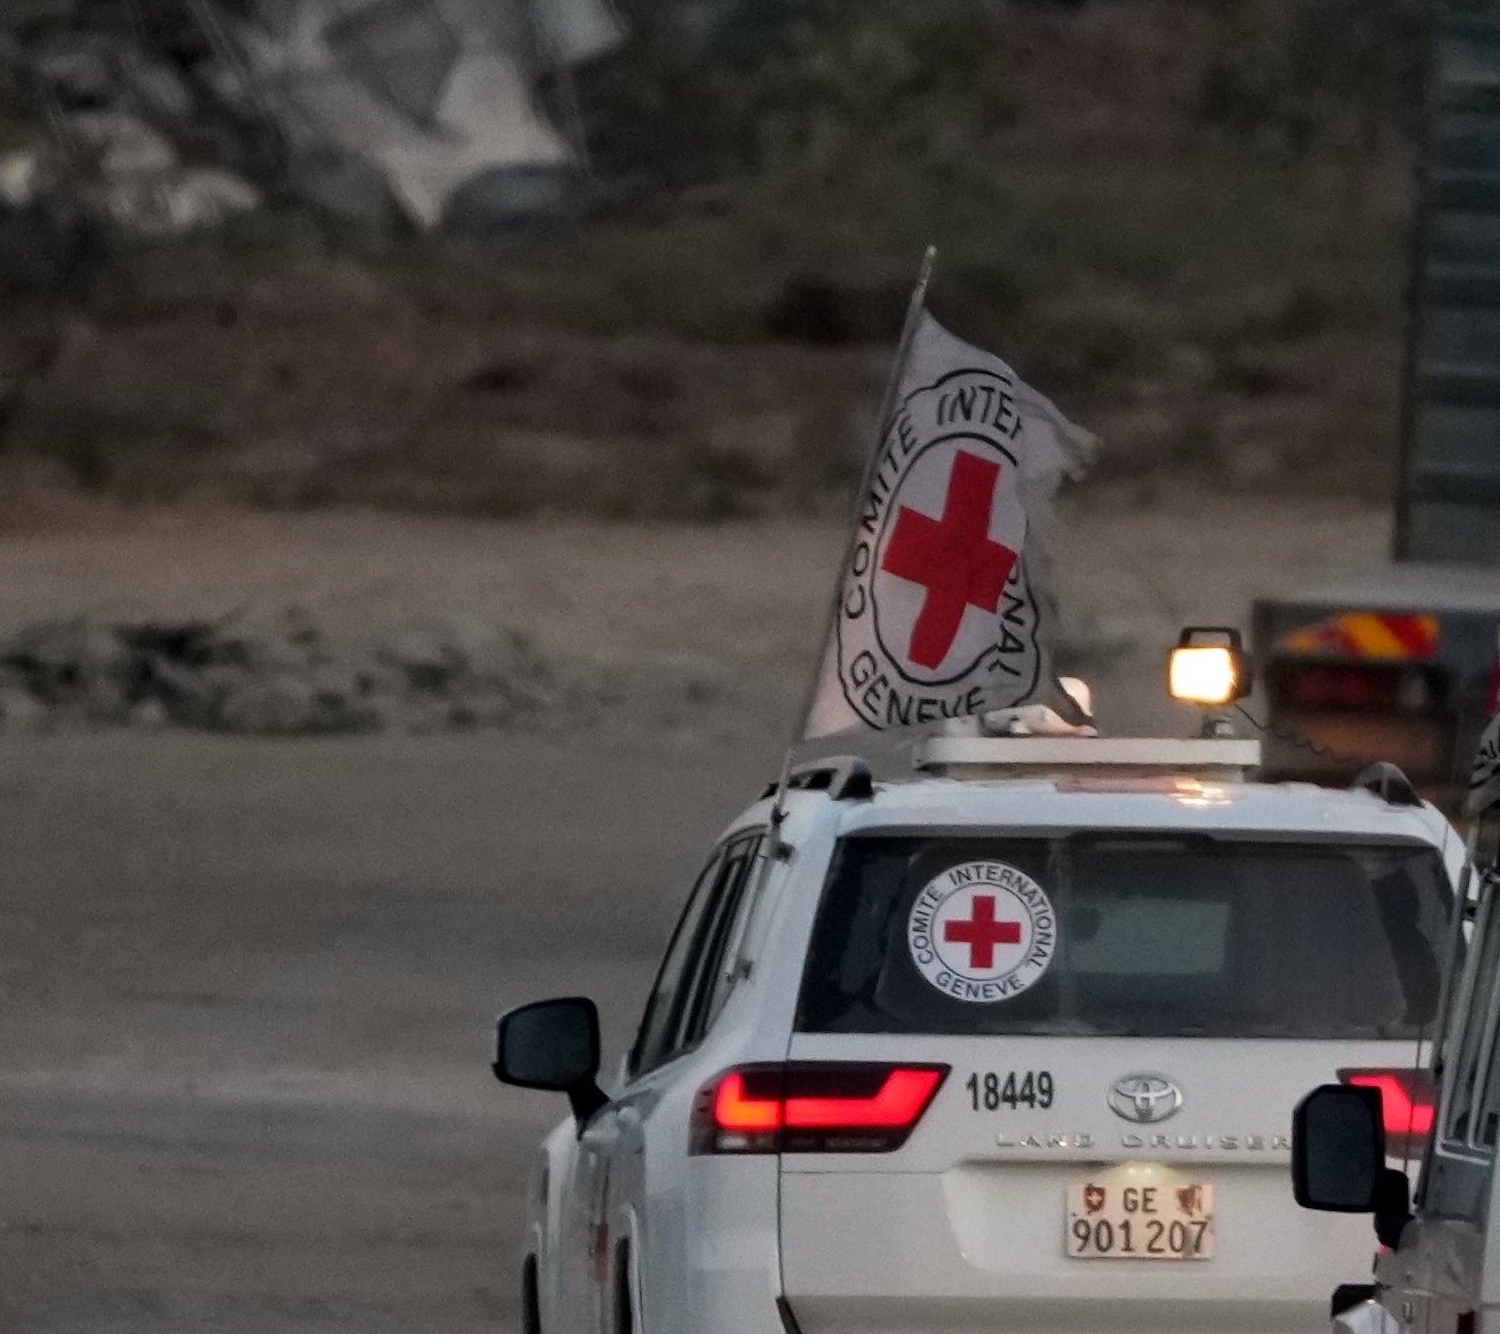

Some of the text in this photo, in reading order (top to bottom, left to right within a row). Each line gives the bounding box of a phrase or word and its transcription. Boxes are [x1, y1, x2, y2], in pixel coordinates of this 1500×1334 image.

[845, 414, 918, 620] COMITE
[851, 650, 986, 728] GENEVE
[912, 864, 1053, 967] COMITE INTERNATIONAL
[936, 971, 1026, 999] GENEVE
[965, 1070, 1053, 1111] 18449
[996, 1132, 1293, 1151] LAND CRUISER
[1123, 1187, 1158, 1214] GE
[1072, 1219, 1209, 1254] 901 207
